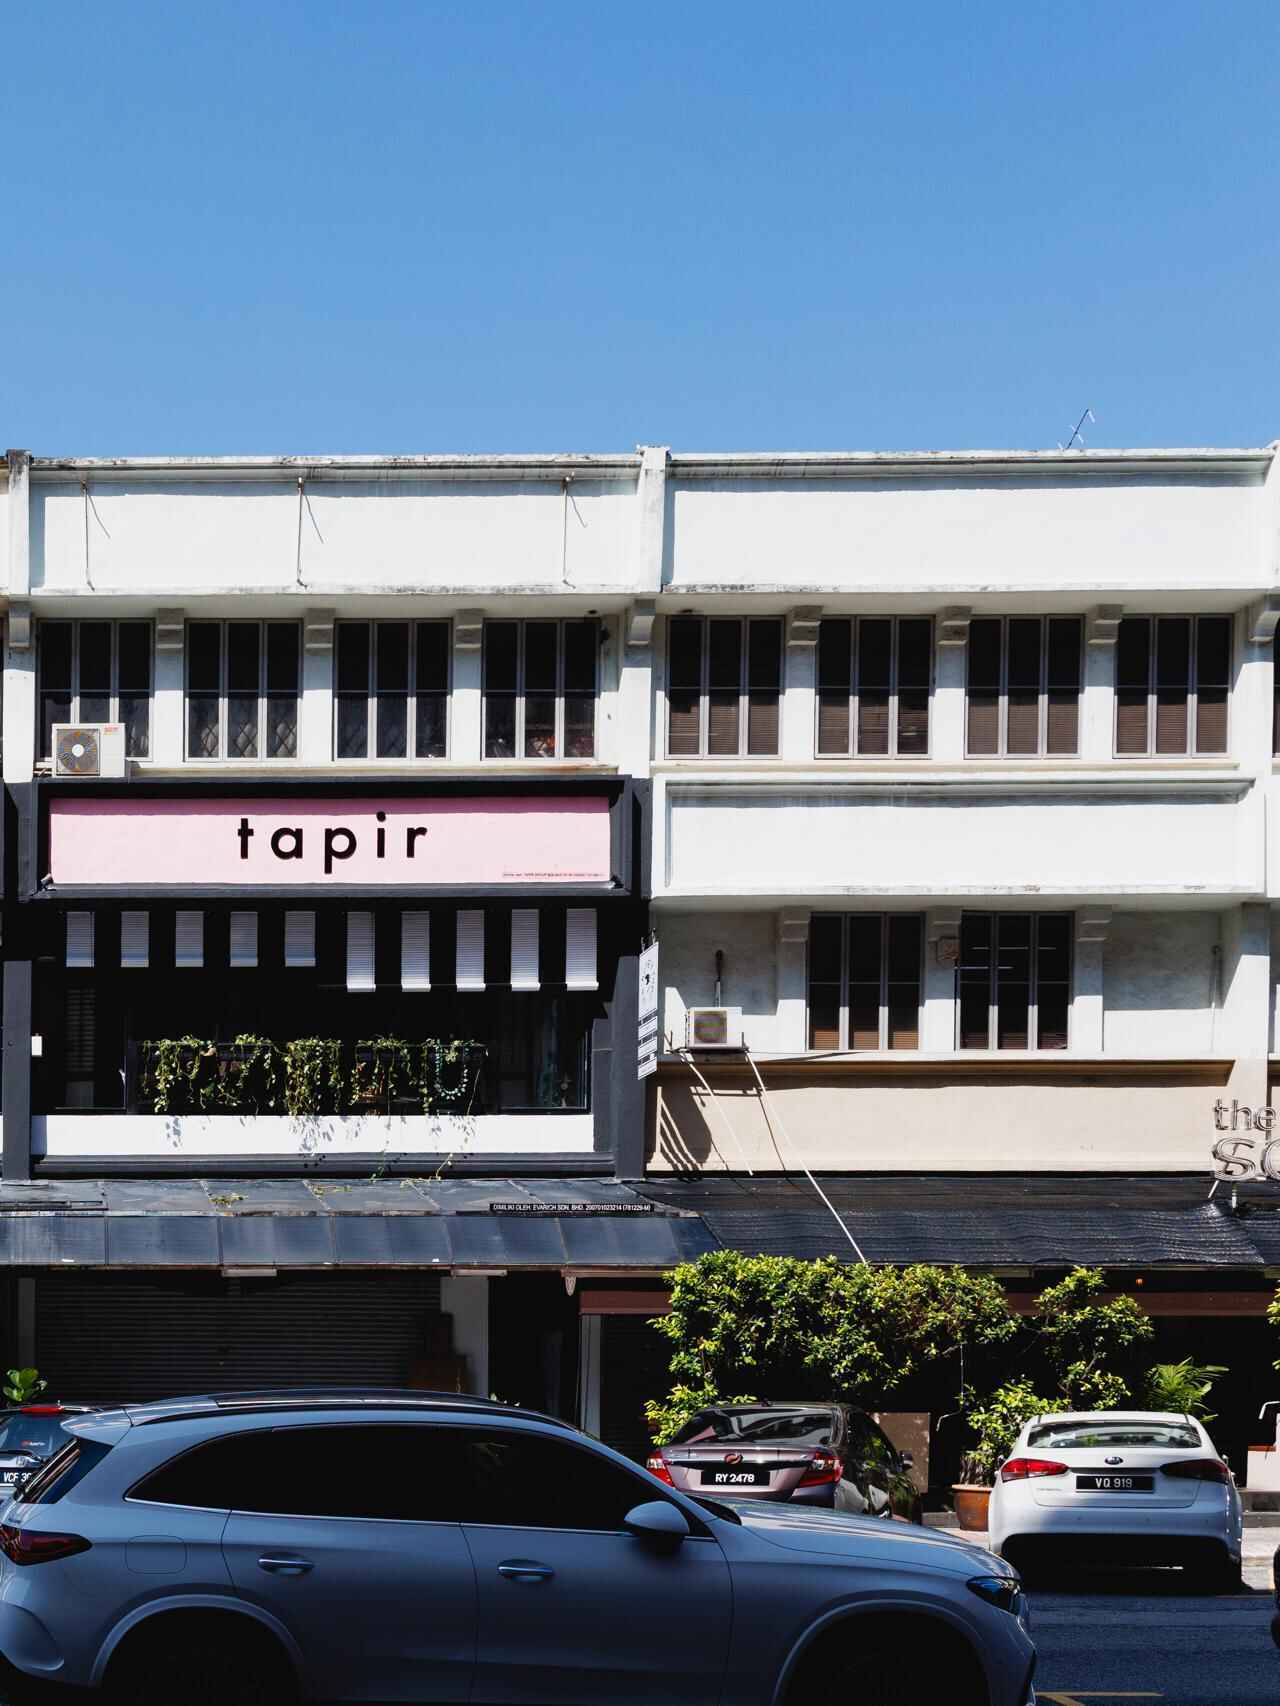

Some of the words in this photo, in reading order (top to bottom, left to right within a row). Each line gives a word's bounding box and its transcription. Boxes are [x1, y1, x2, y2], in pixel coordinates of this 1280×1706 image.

[237, 811, 428, 874] tapir
[1213, 1098, 1277, 1131] the
[715, 1473, 729, 1483] RY
[729, 1473, 755, 1483] 2478
[1113, 1478, 1133, 1488] 919
